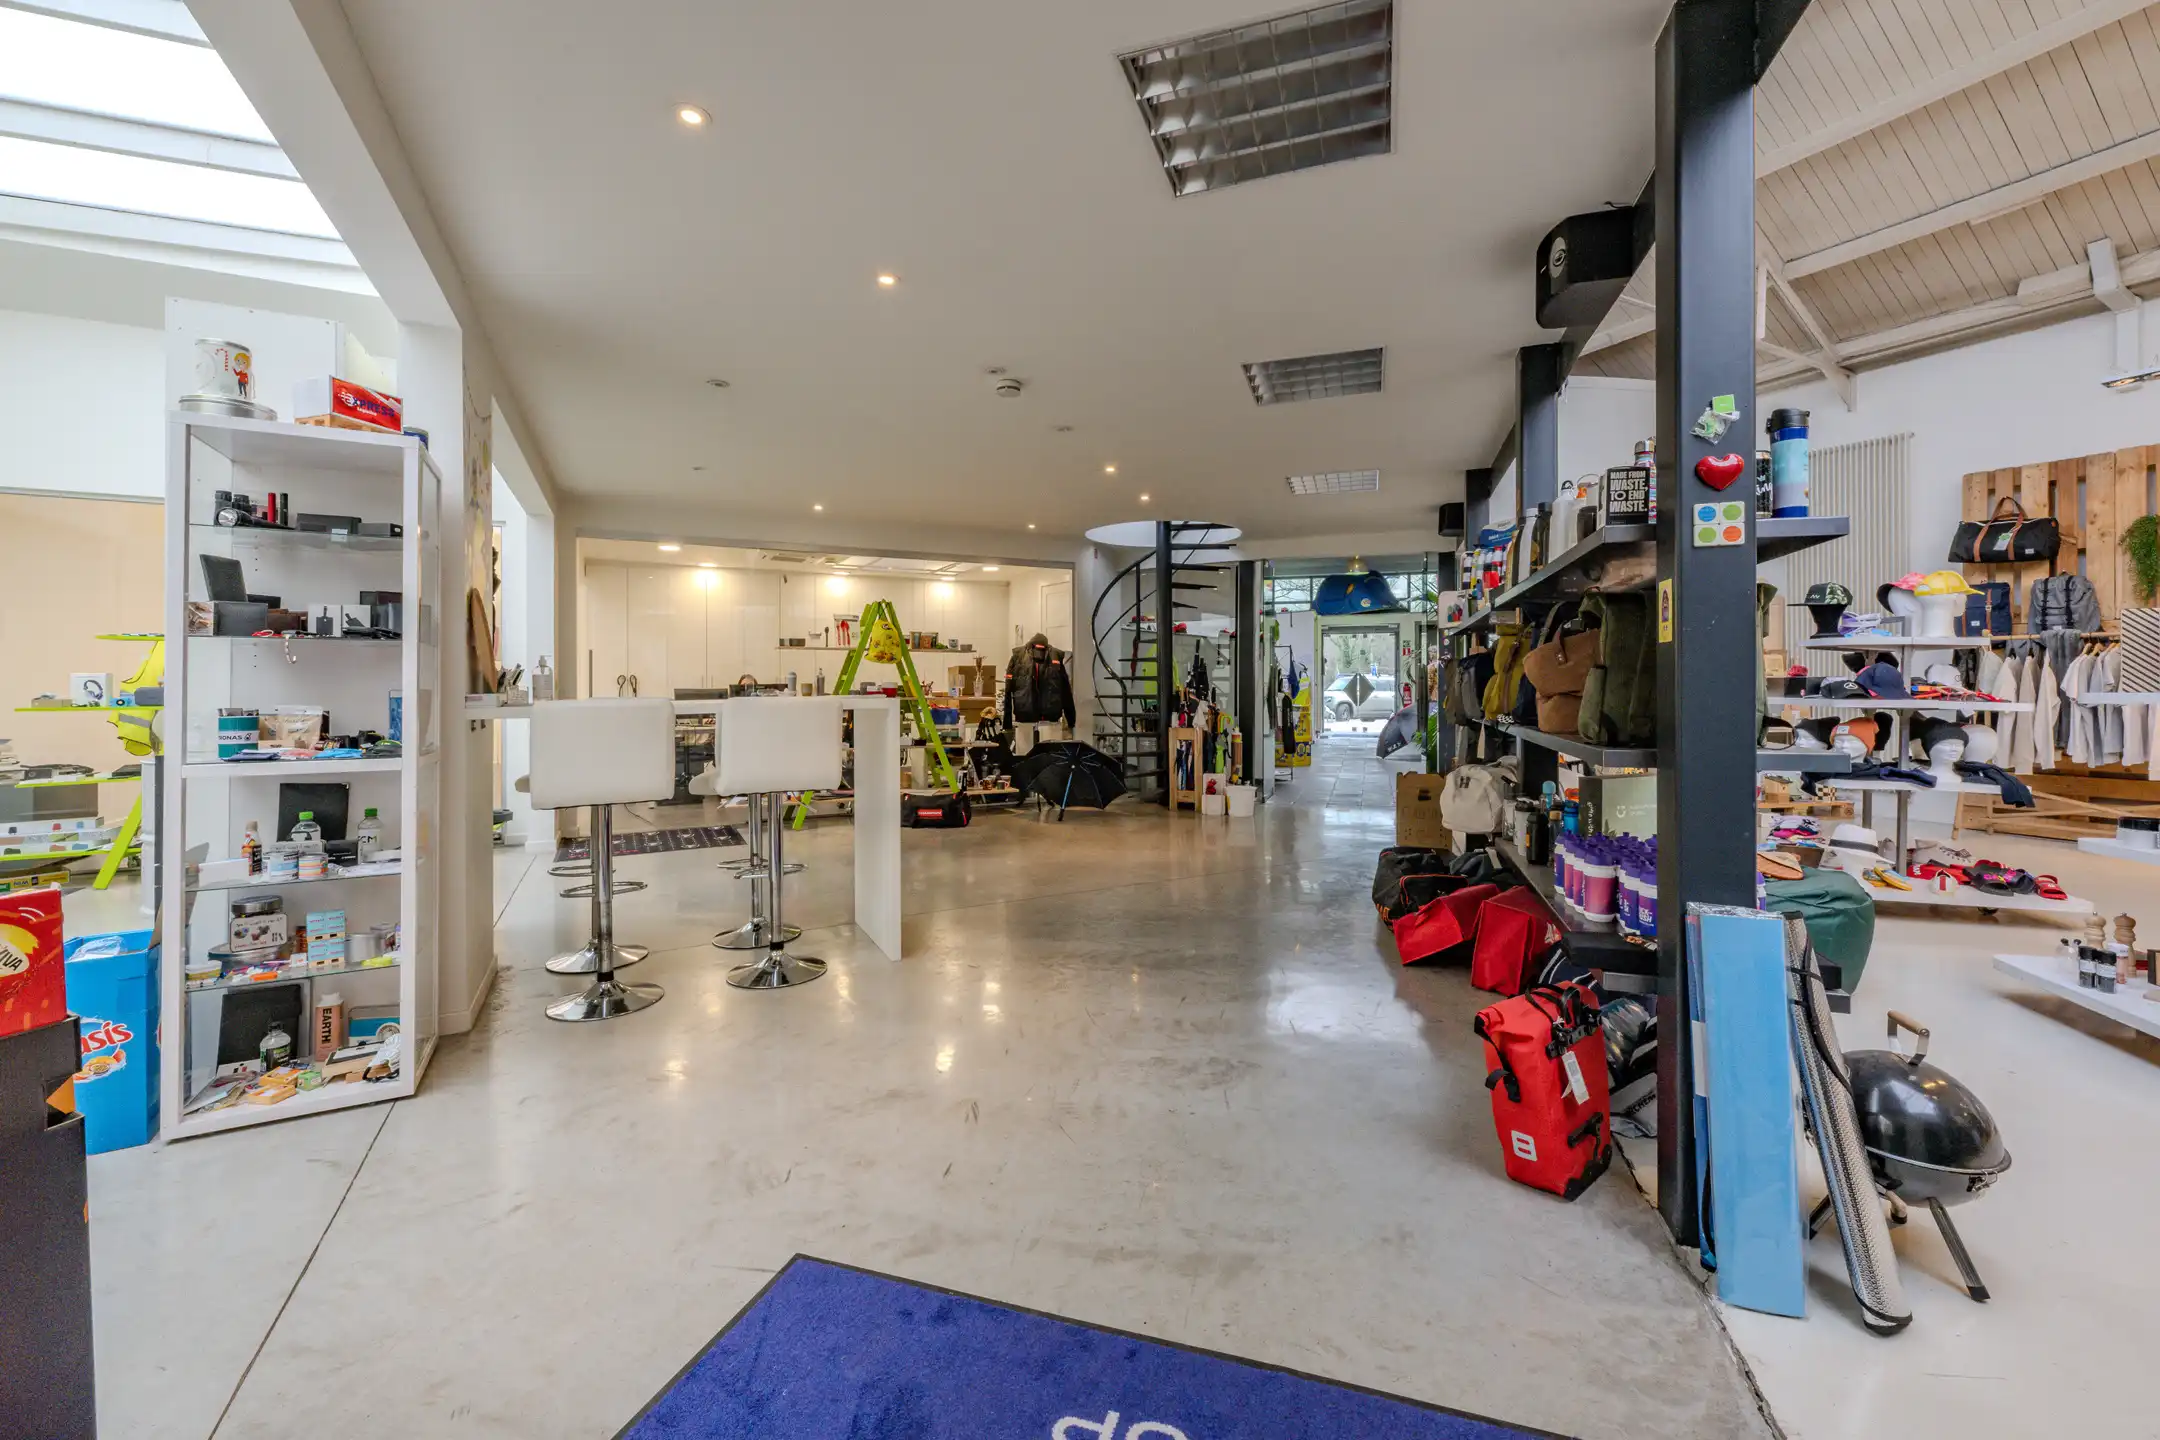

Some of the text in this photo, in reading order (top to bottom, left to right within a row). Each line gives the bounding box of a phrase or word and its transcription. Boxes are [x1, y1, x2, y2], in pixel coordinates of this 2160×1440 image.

[1610, 470, 1646, 479] MADE FROM
[1610, 479, 1648, 491] WASTE,
[1610, 490, 1645, 500] TO END
[1610, 500, 1648, 512] WASTE.
[321, 1007, 333, 1045] EARTH
